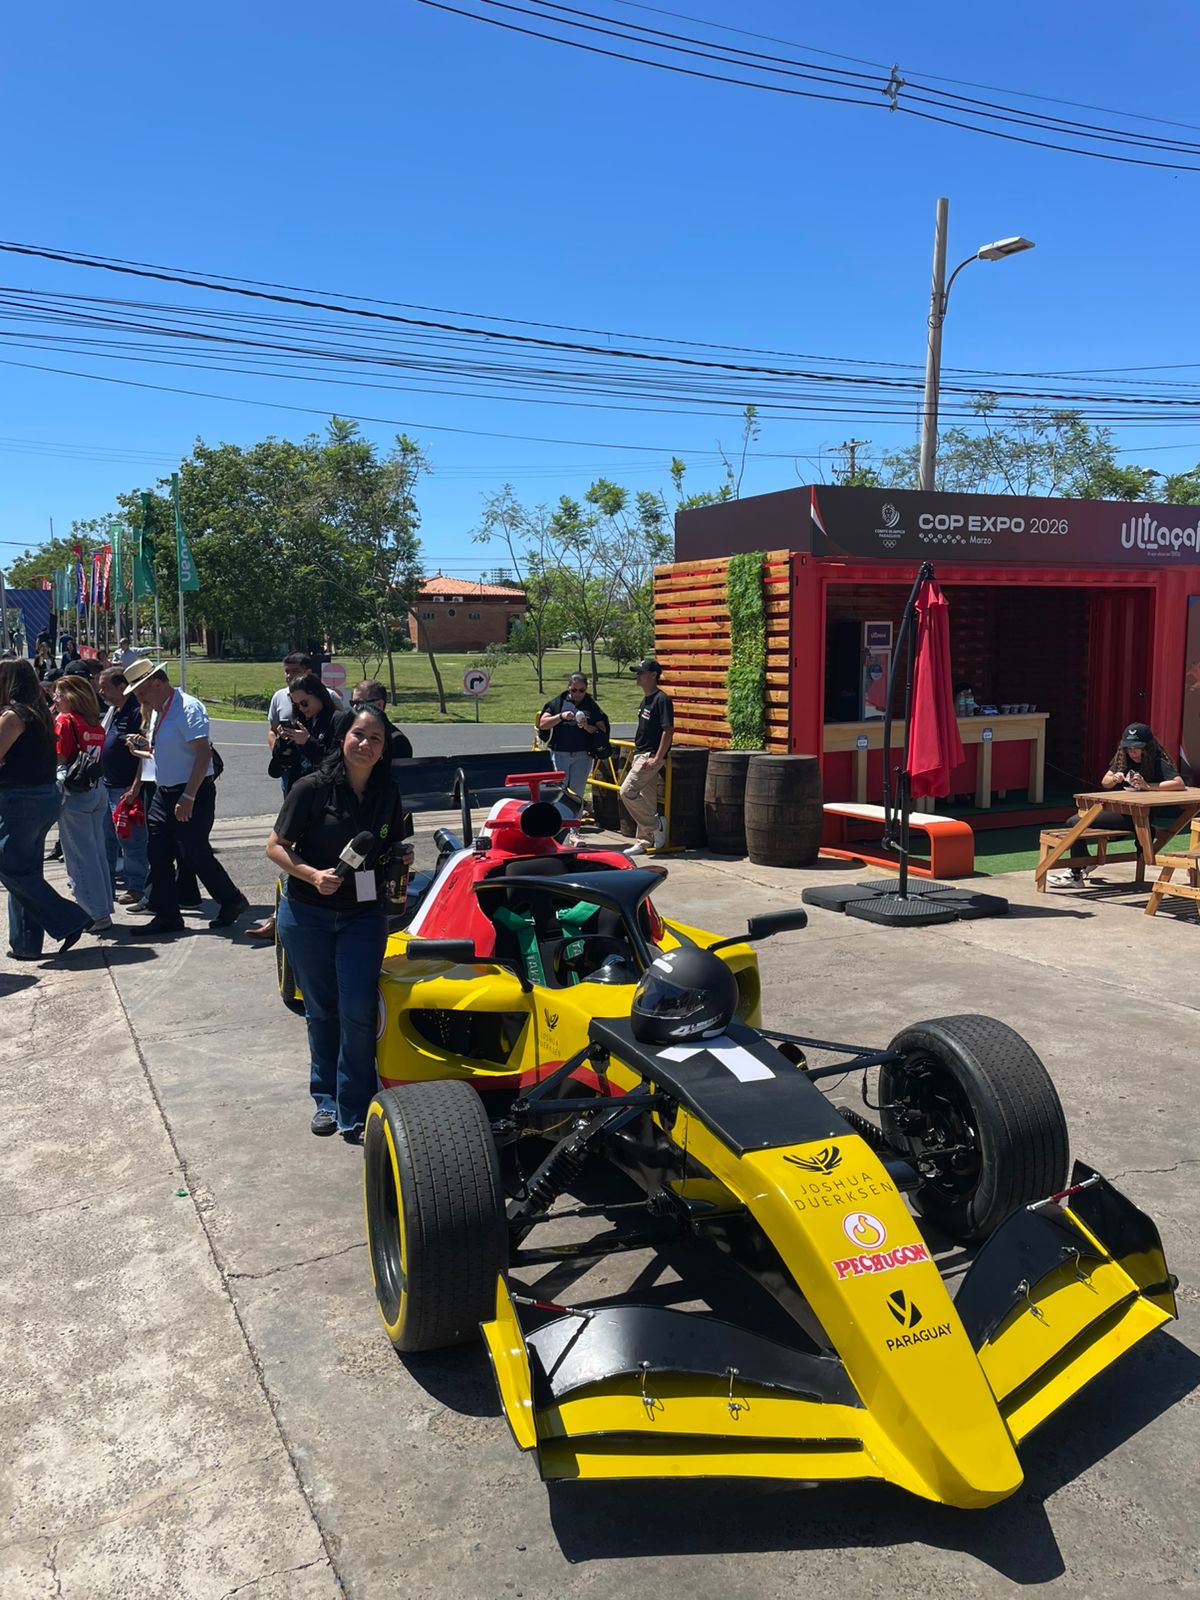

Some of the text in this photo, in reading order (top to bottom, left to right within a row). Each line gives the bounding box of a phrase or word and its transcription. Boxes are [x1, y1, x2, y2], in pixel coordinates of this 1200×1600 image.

[918, 513, 1069, 535] COP EXPO 2026
[969, 535, 992, 545] Marzo
[793, 1181, 894, 1211] DUERKSEN
[800, 1171, 873, 1195] JOSHUA
[832, 1243, 931, 1279] PECHUGON
[886, 1322, 952, 1352] PARAGUAY
